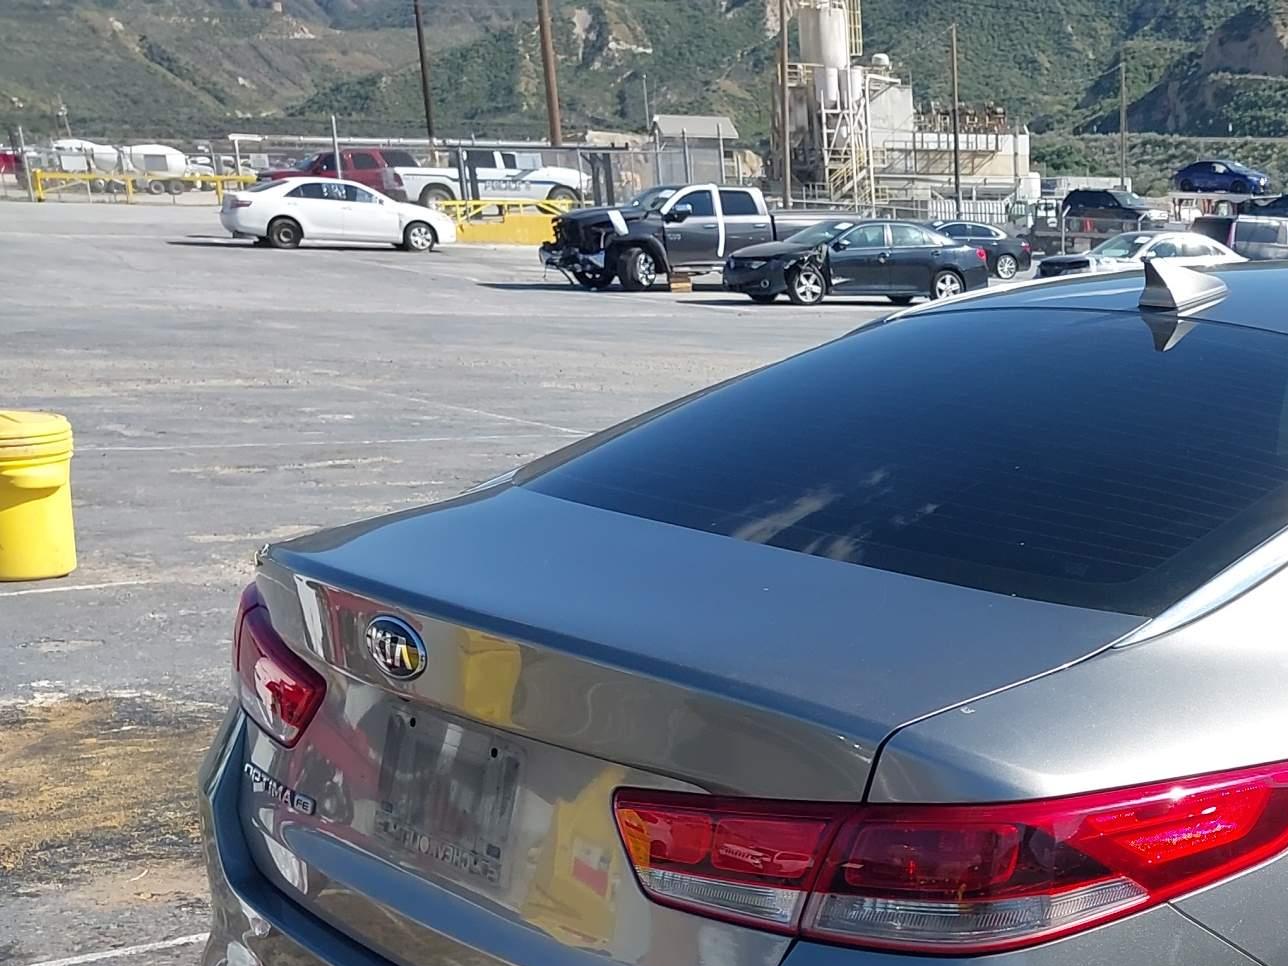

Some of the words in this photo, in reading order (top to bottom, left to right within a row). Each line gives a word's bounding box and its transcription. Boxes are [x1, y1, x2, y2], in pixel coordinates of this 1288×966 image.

[366, 628, 412, 672] KIA
[244, 764, 293, 808] OPTIMA
[295, 798, 310, 811] FE
